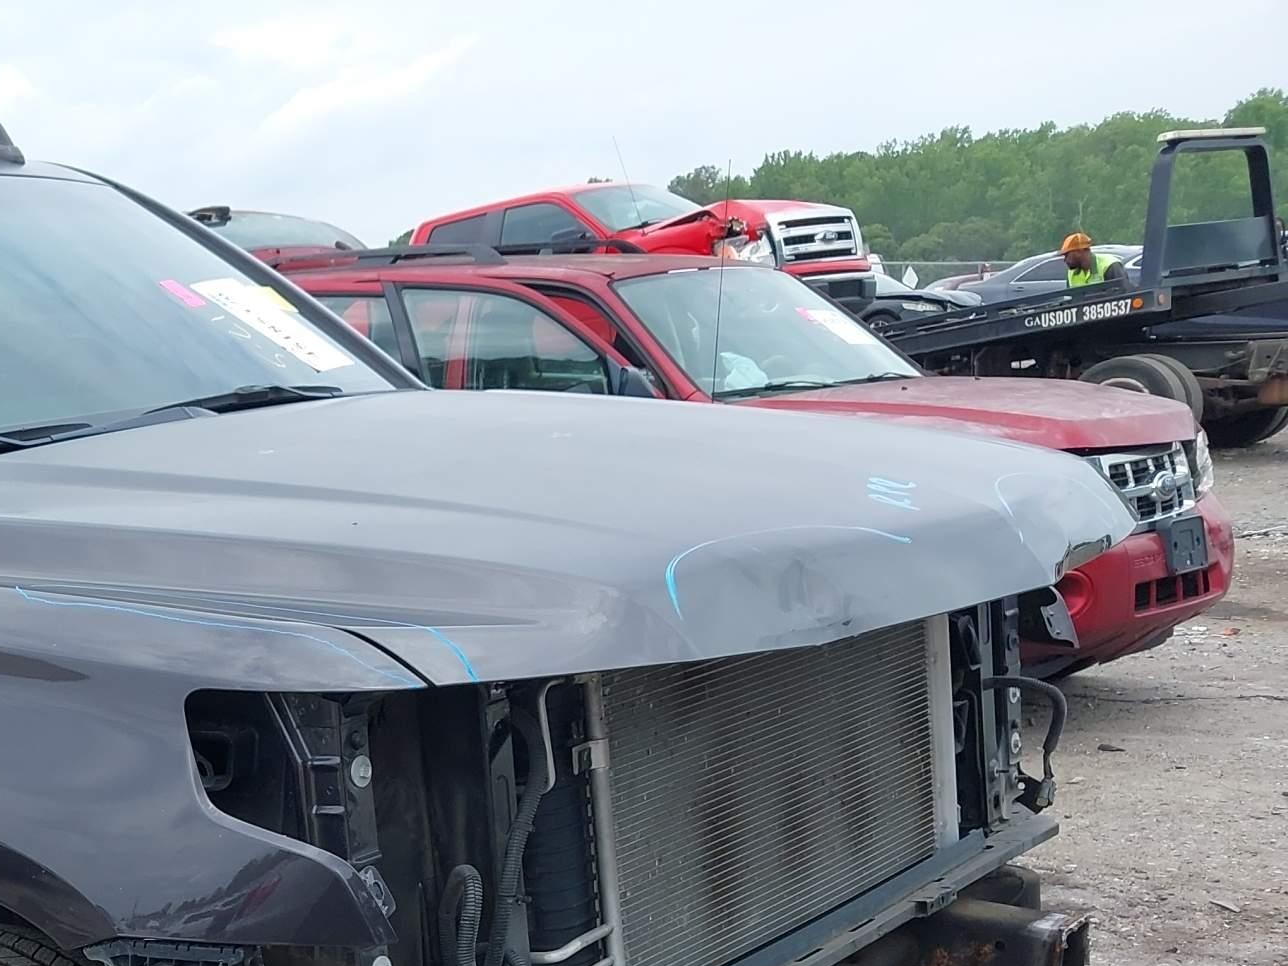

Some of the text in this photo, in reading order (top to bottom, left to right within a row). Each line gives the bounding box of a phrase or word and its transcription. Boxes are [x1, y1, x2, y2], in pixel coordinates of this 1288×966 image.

[1024, 298, 1132, 328] GA USDOT 3850537
